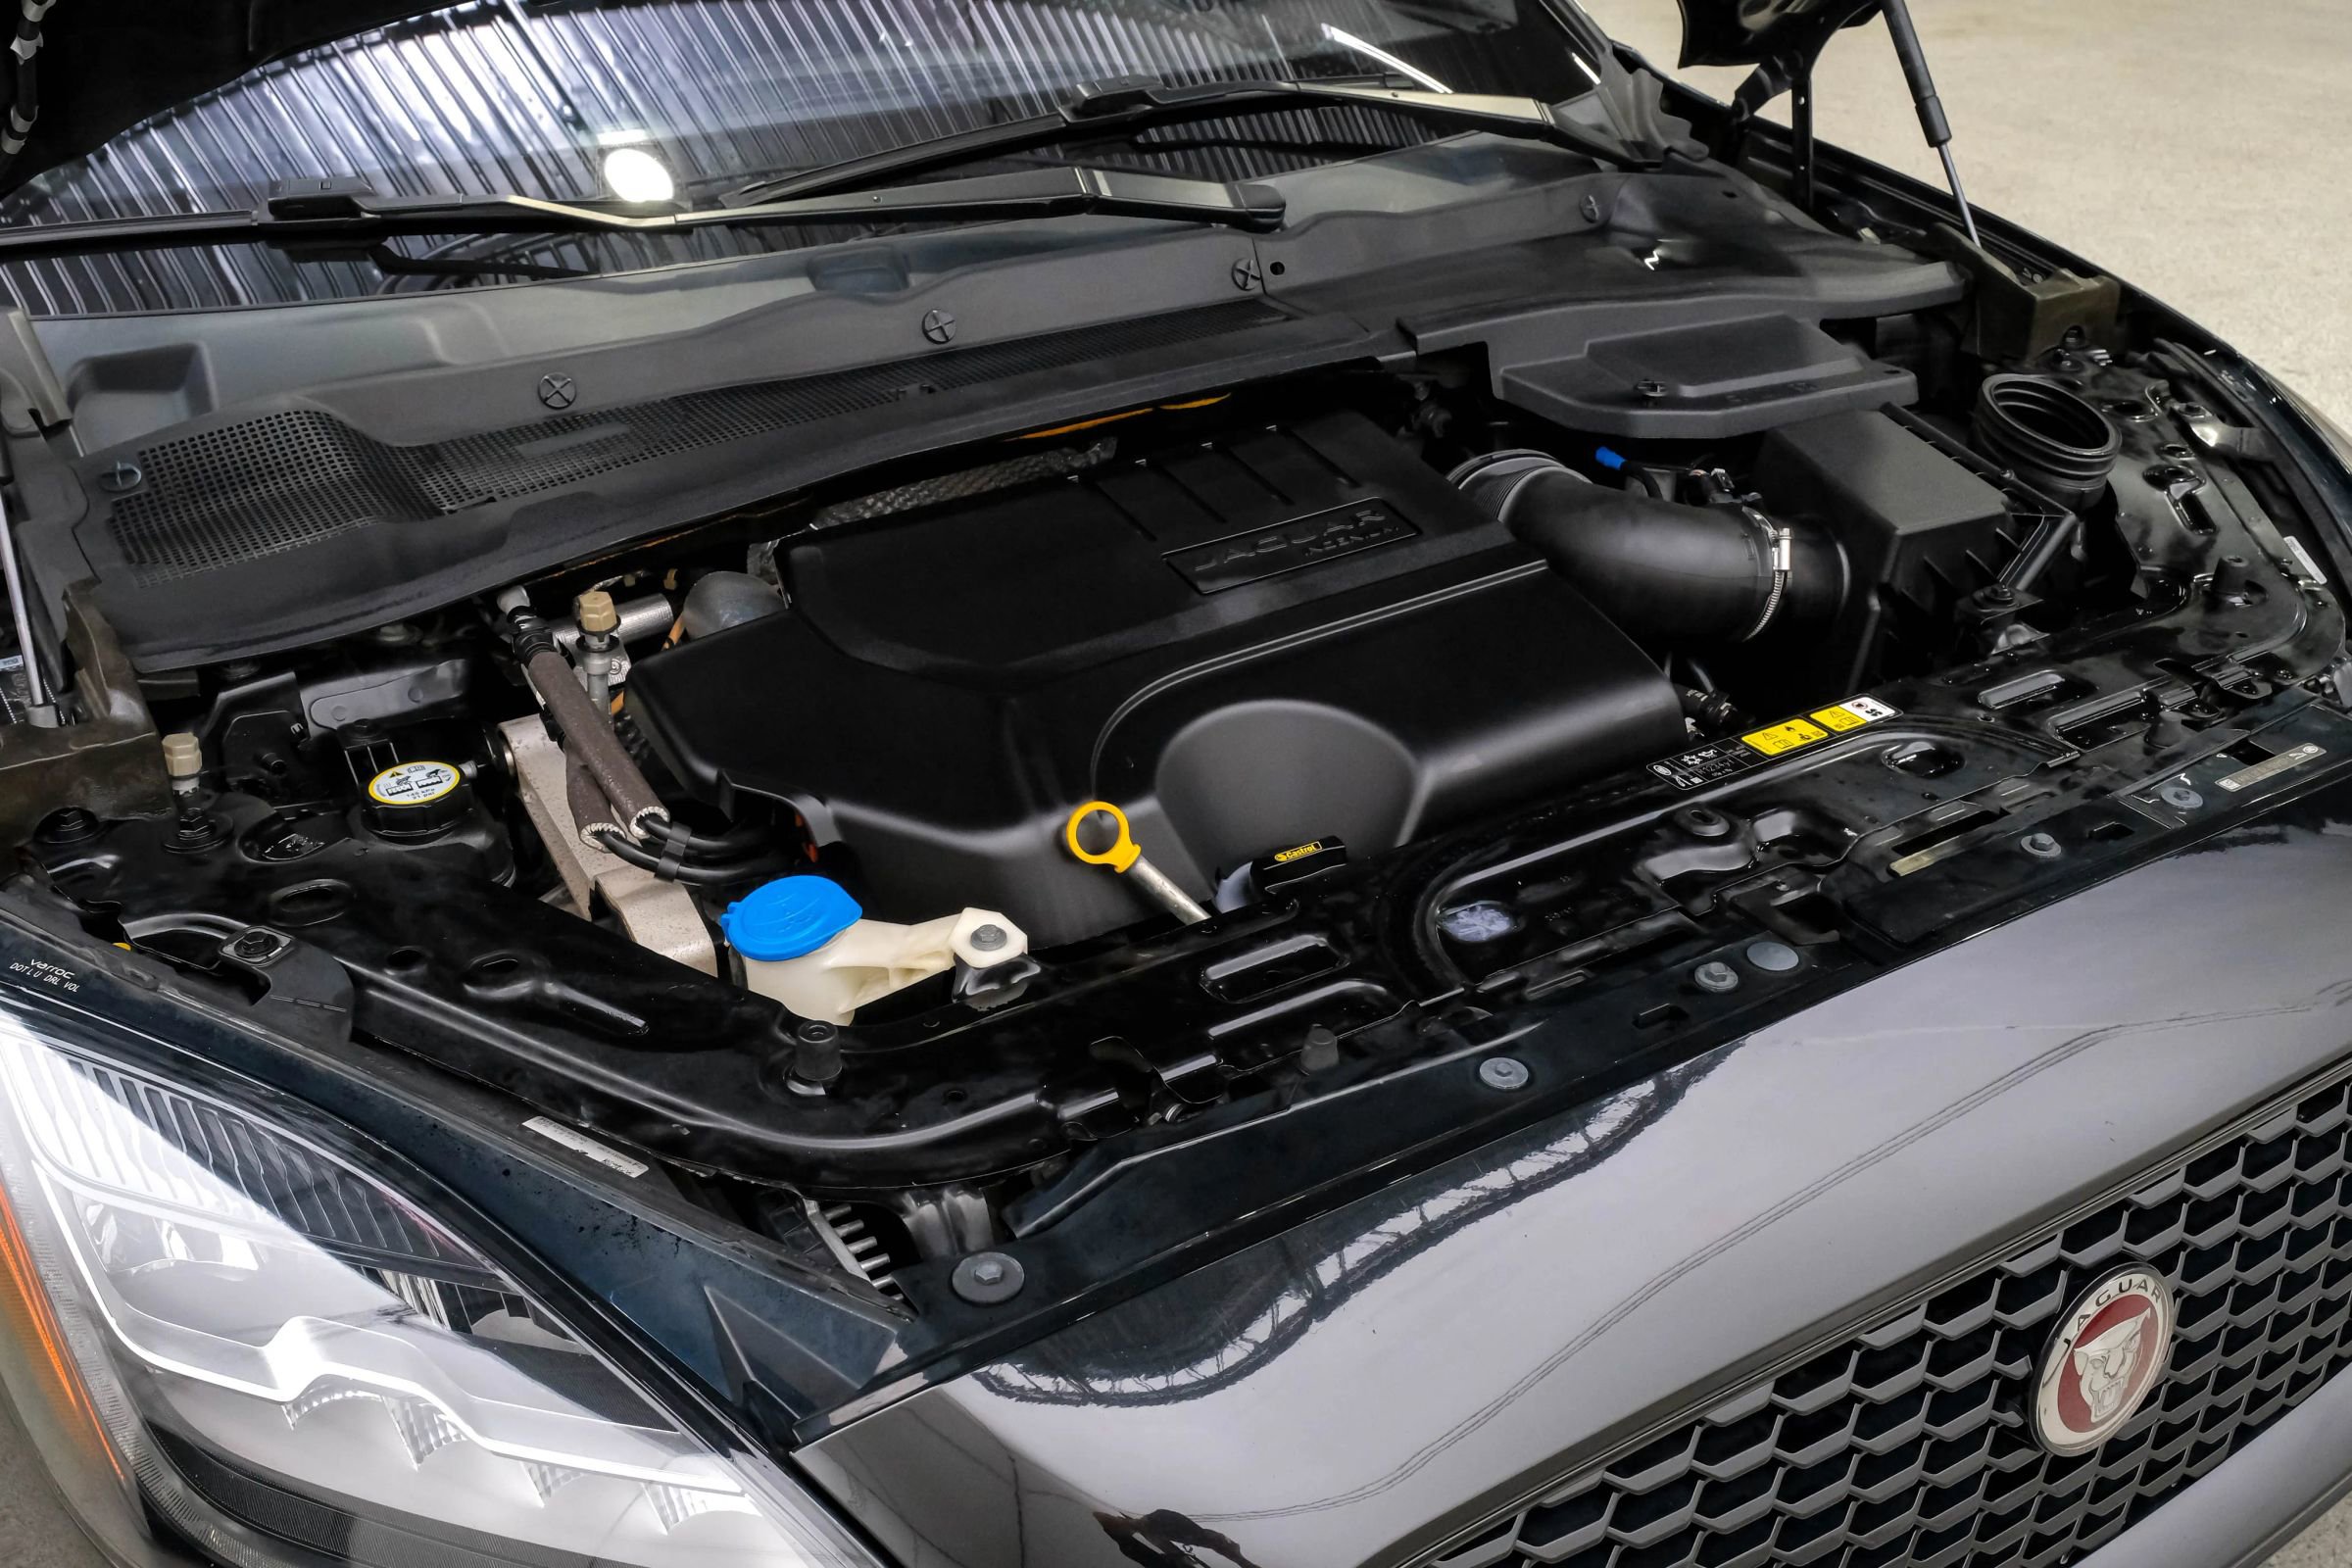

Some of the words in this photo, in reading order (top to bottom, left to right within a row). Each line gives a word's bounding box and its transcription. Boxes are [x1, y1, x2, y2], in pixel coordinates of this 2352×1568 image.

[1194, 509, 1387, 572] JAGUAR
[1286, 844, 1316, 858] Castrol
[9, 962, 29, 973] DOT
[43, 974, 61, 986] DRL
[63, 981, 80, 993] VOL
[2060, 1278, 2162, 1358] JAGUAR
